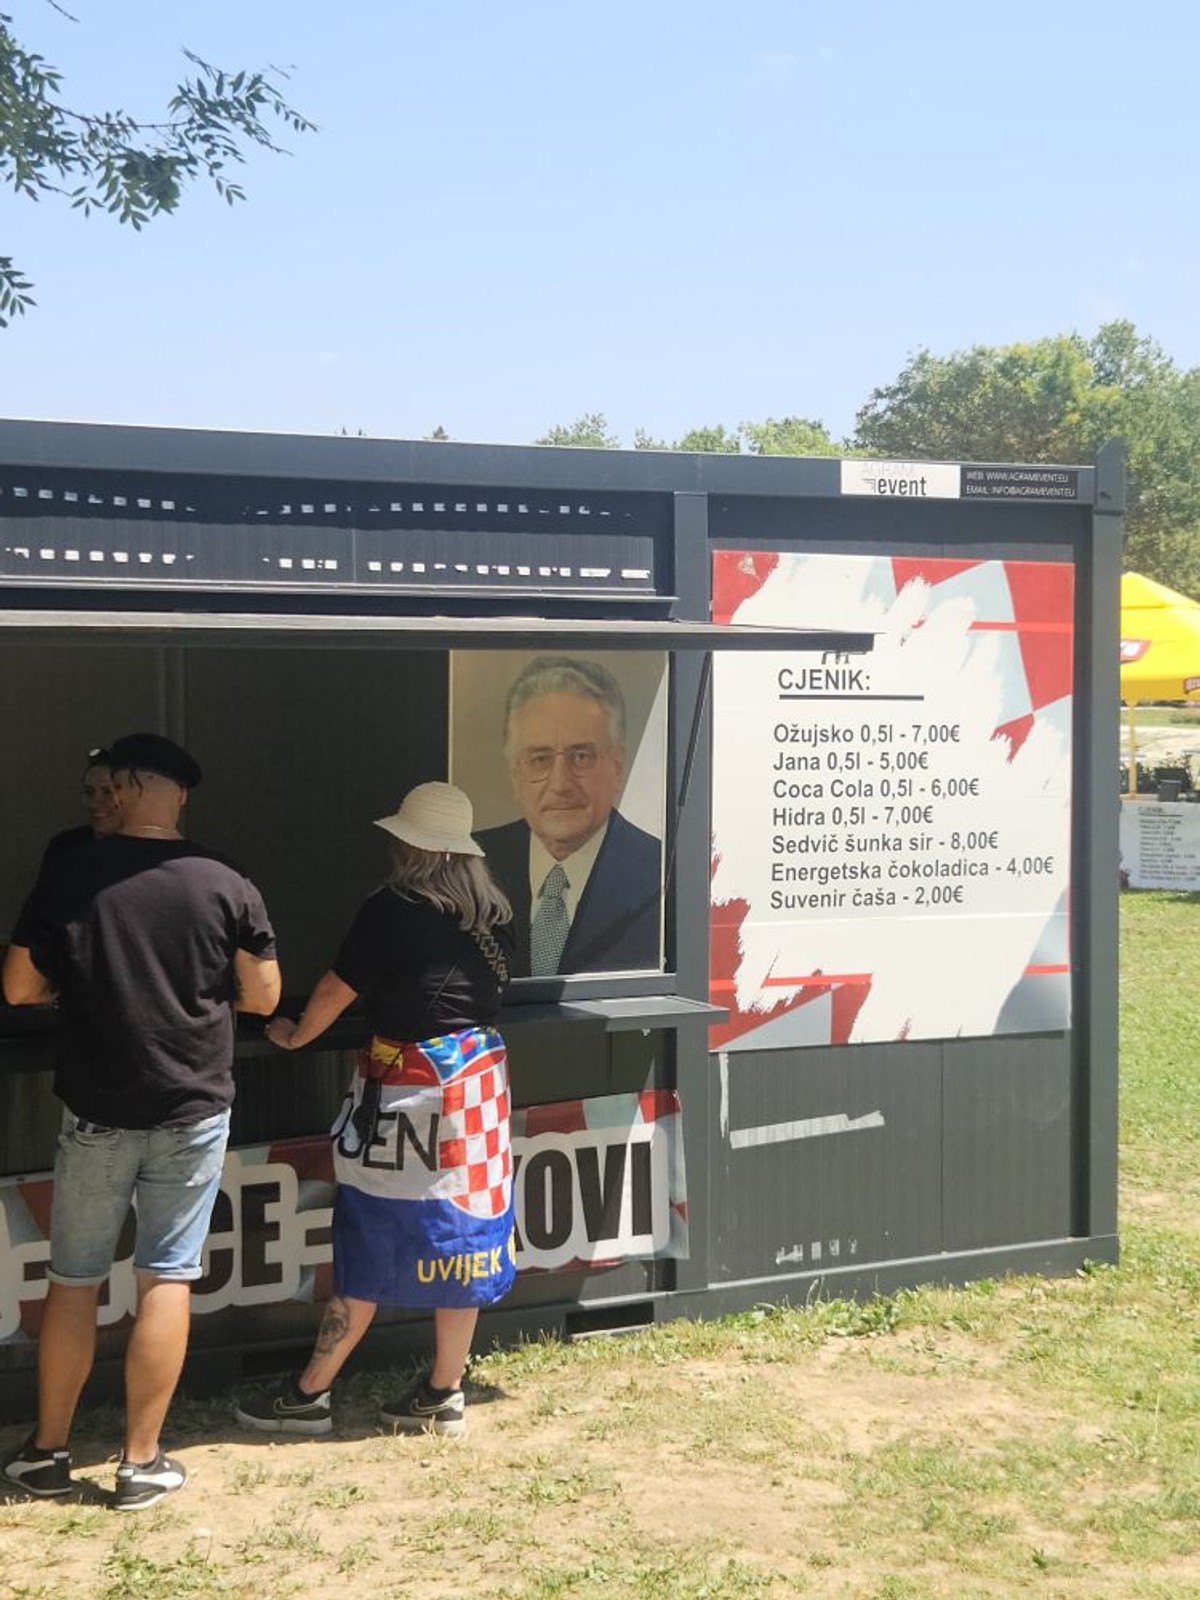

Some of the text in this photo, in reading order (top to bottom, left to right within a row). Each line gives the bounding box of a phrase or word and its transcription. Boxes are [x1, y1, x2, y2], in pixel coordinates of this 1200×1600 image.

[878, 477, 926, 496] event
[777, 668, 871, 691] CJENIK:
[774, 723, 854, 748] Ožujsko
[911, 724, 960, 744] 7,00€
[772, 752, 820, 771] Jana
[879, 751, 929, 772] 5,00€
[773, 779, 824, 799] Coca
[830, 779, 874, 798] Cola
[931, 778, 979, 799] 6,00€
[773, 807, 825, 827] Hidra
[884, 805, 933, 827] 7,00€
[772, 834, 839, 854] Sedvič
[844, 833, 902, 853] šunka
[908, 832, 934, 851] sir
[950, 831, 998, 852] 8,00€
[771, 862, 882, 886] Energetska
[888, 859, 989, 879] čokoladica
[1006, 857, 1054, 877] 4,00€
[770, 889, 847, 910] Suvenir
[852, 887, 896, 907] čaša
[914, 885, 964, 907] 2,00€
[417, 1244, 503, 1287] UVIJEK
